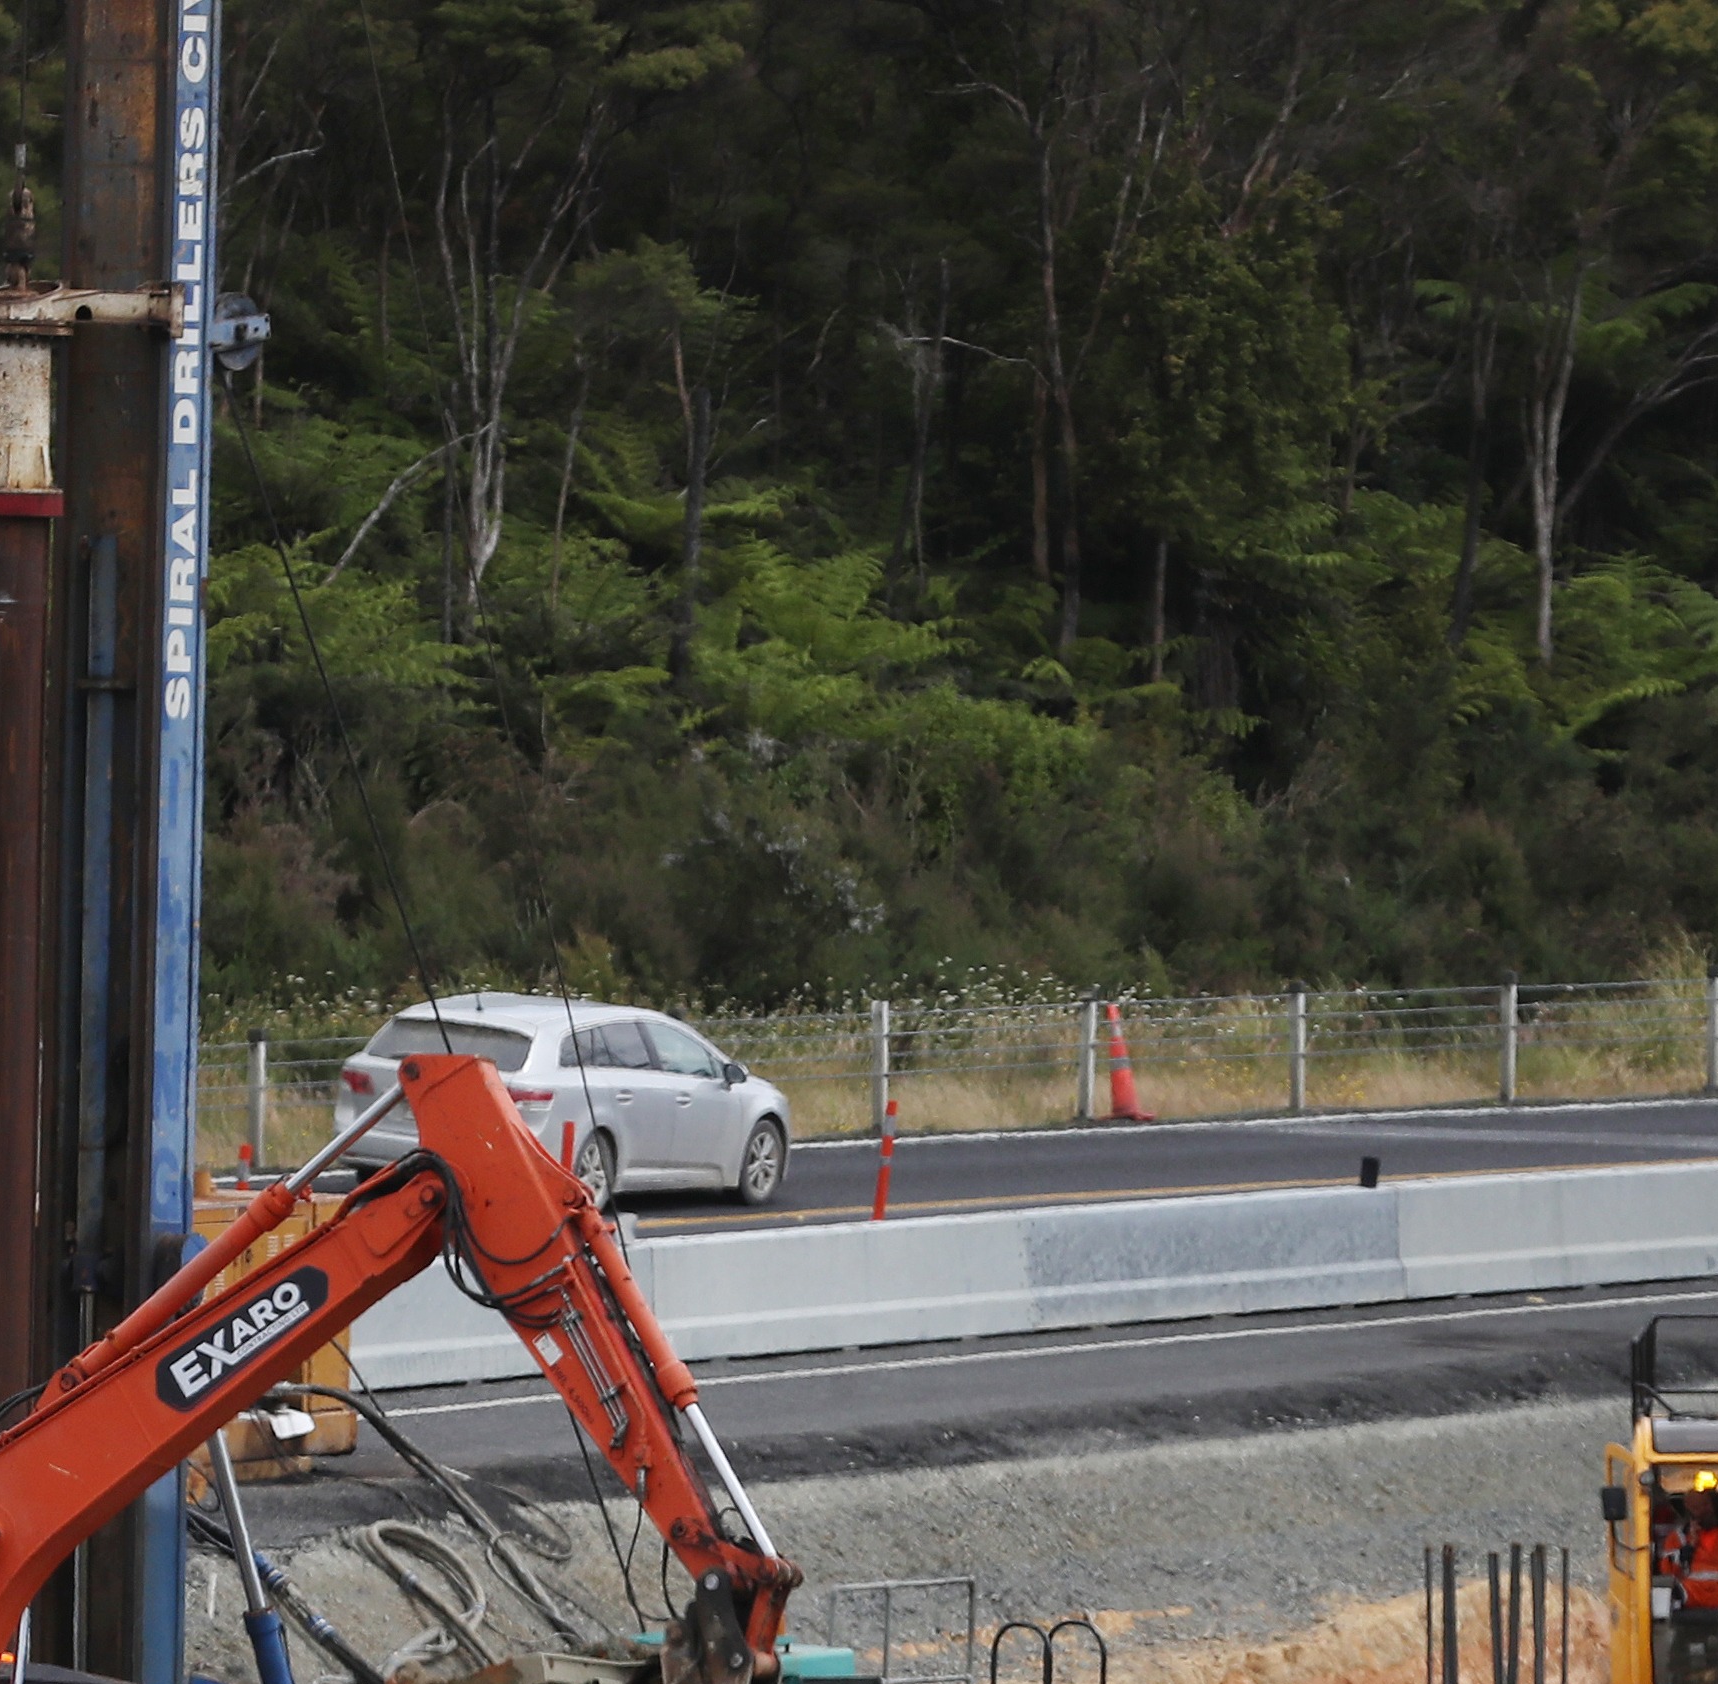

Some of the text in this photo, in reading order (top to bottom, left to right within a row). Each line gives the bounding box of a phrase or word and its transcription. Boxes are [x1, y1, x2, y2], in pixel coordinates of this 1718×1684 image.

[164, 0, 208, 721] SPIRAL DRILLERS CI
[169, 1282, 301, 1398] EXARO
[236, 1303, 307, 1357] CONTRACTING LTD
